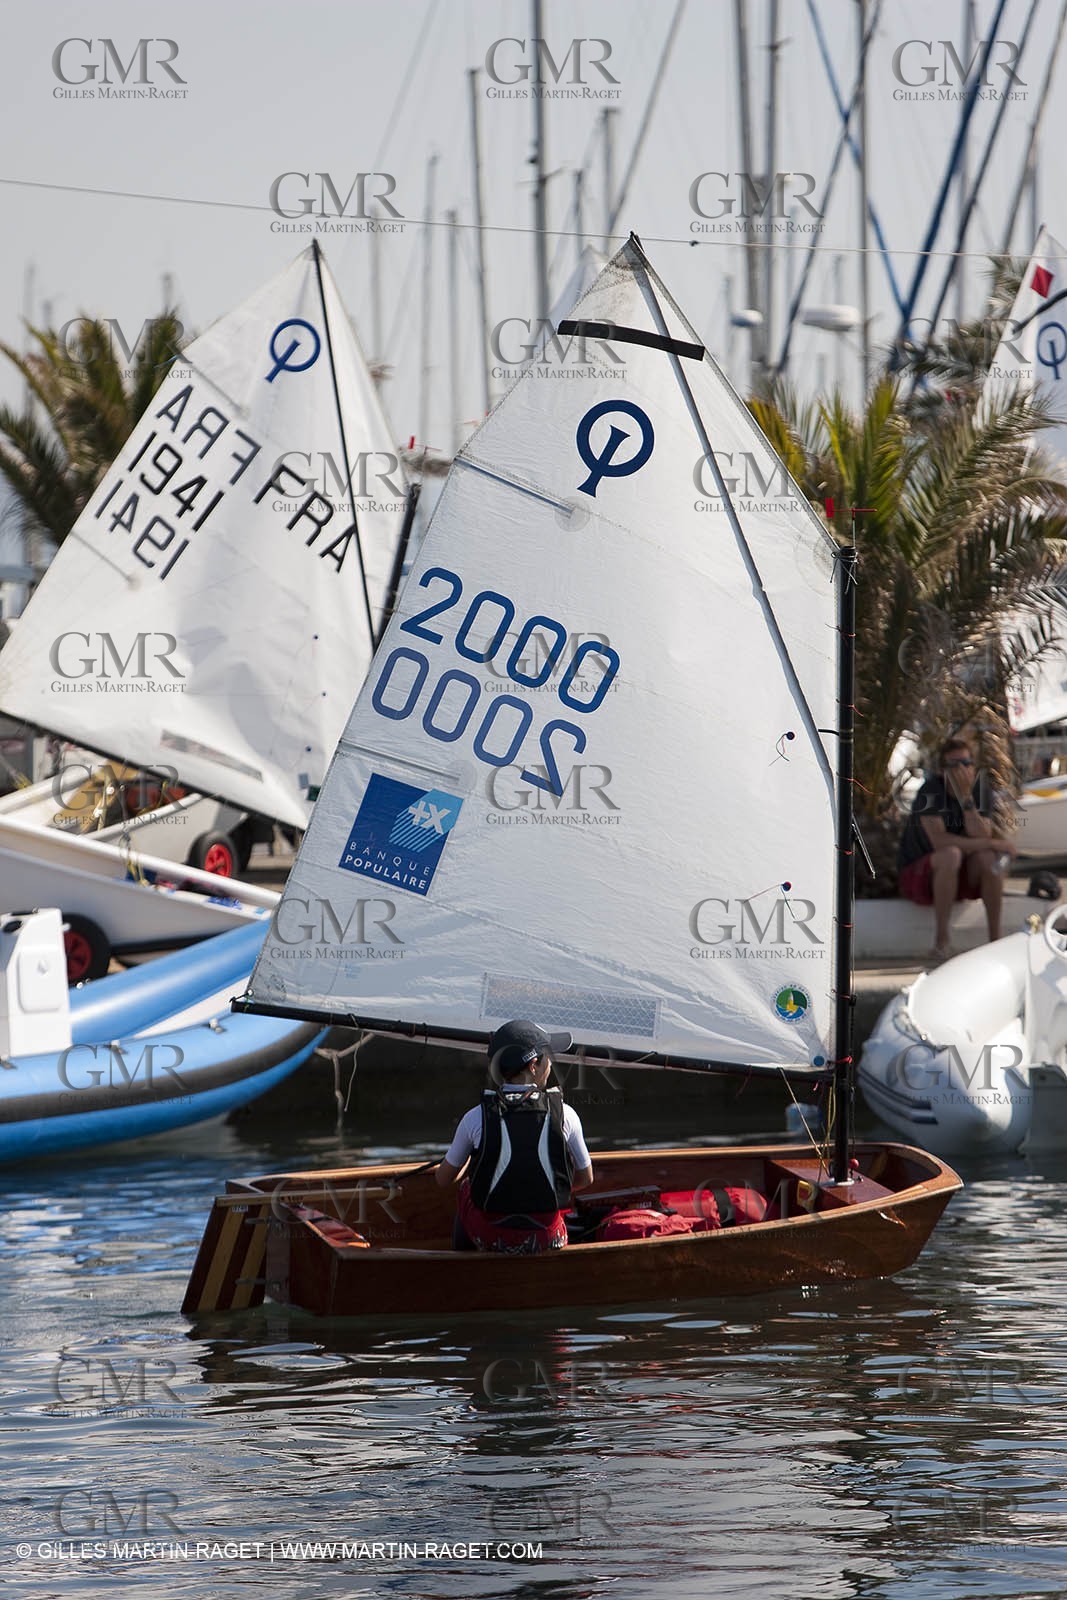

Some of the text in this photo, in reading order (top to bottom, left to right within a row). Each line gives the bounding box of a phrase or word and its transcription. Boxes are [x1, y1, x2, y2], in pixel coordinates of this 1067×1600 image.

[127, 431, 225, 532] 1941
[253, 464, 357, 574] FRA
[400, 566, 621, 714] 2000
[344, 854, 428, 890] POPULAIRE
[349, 841, 434, 876] BANQUE
